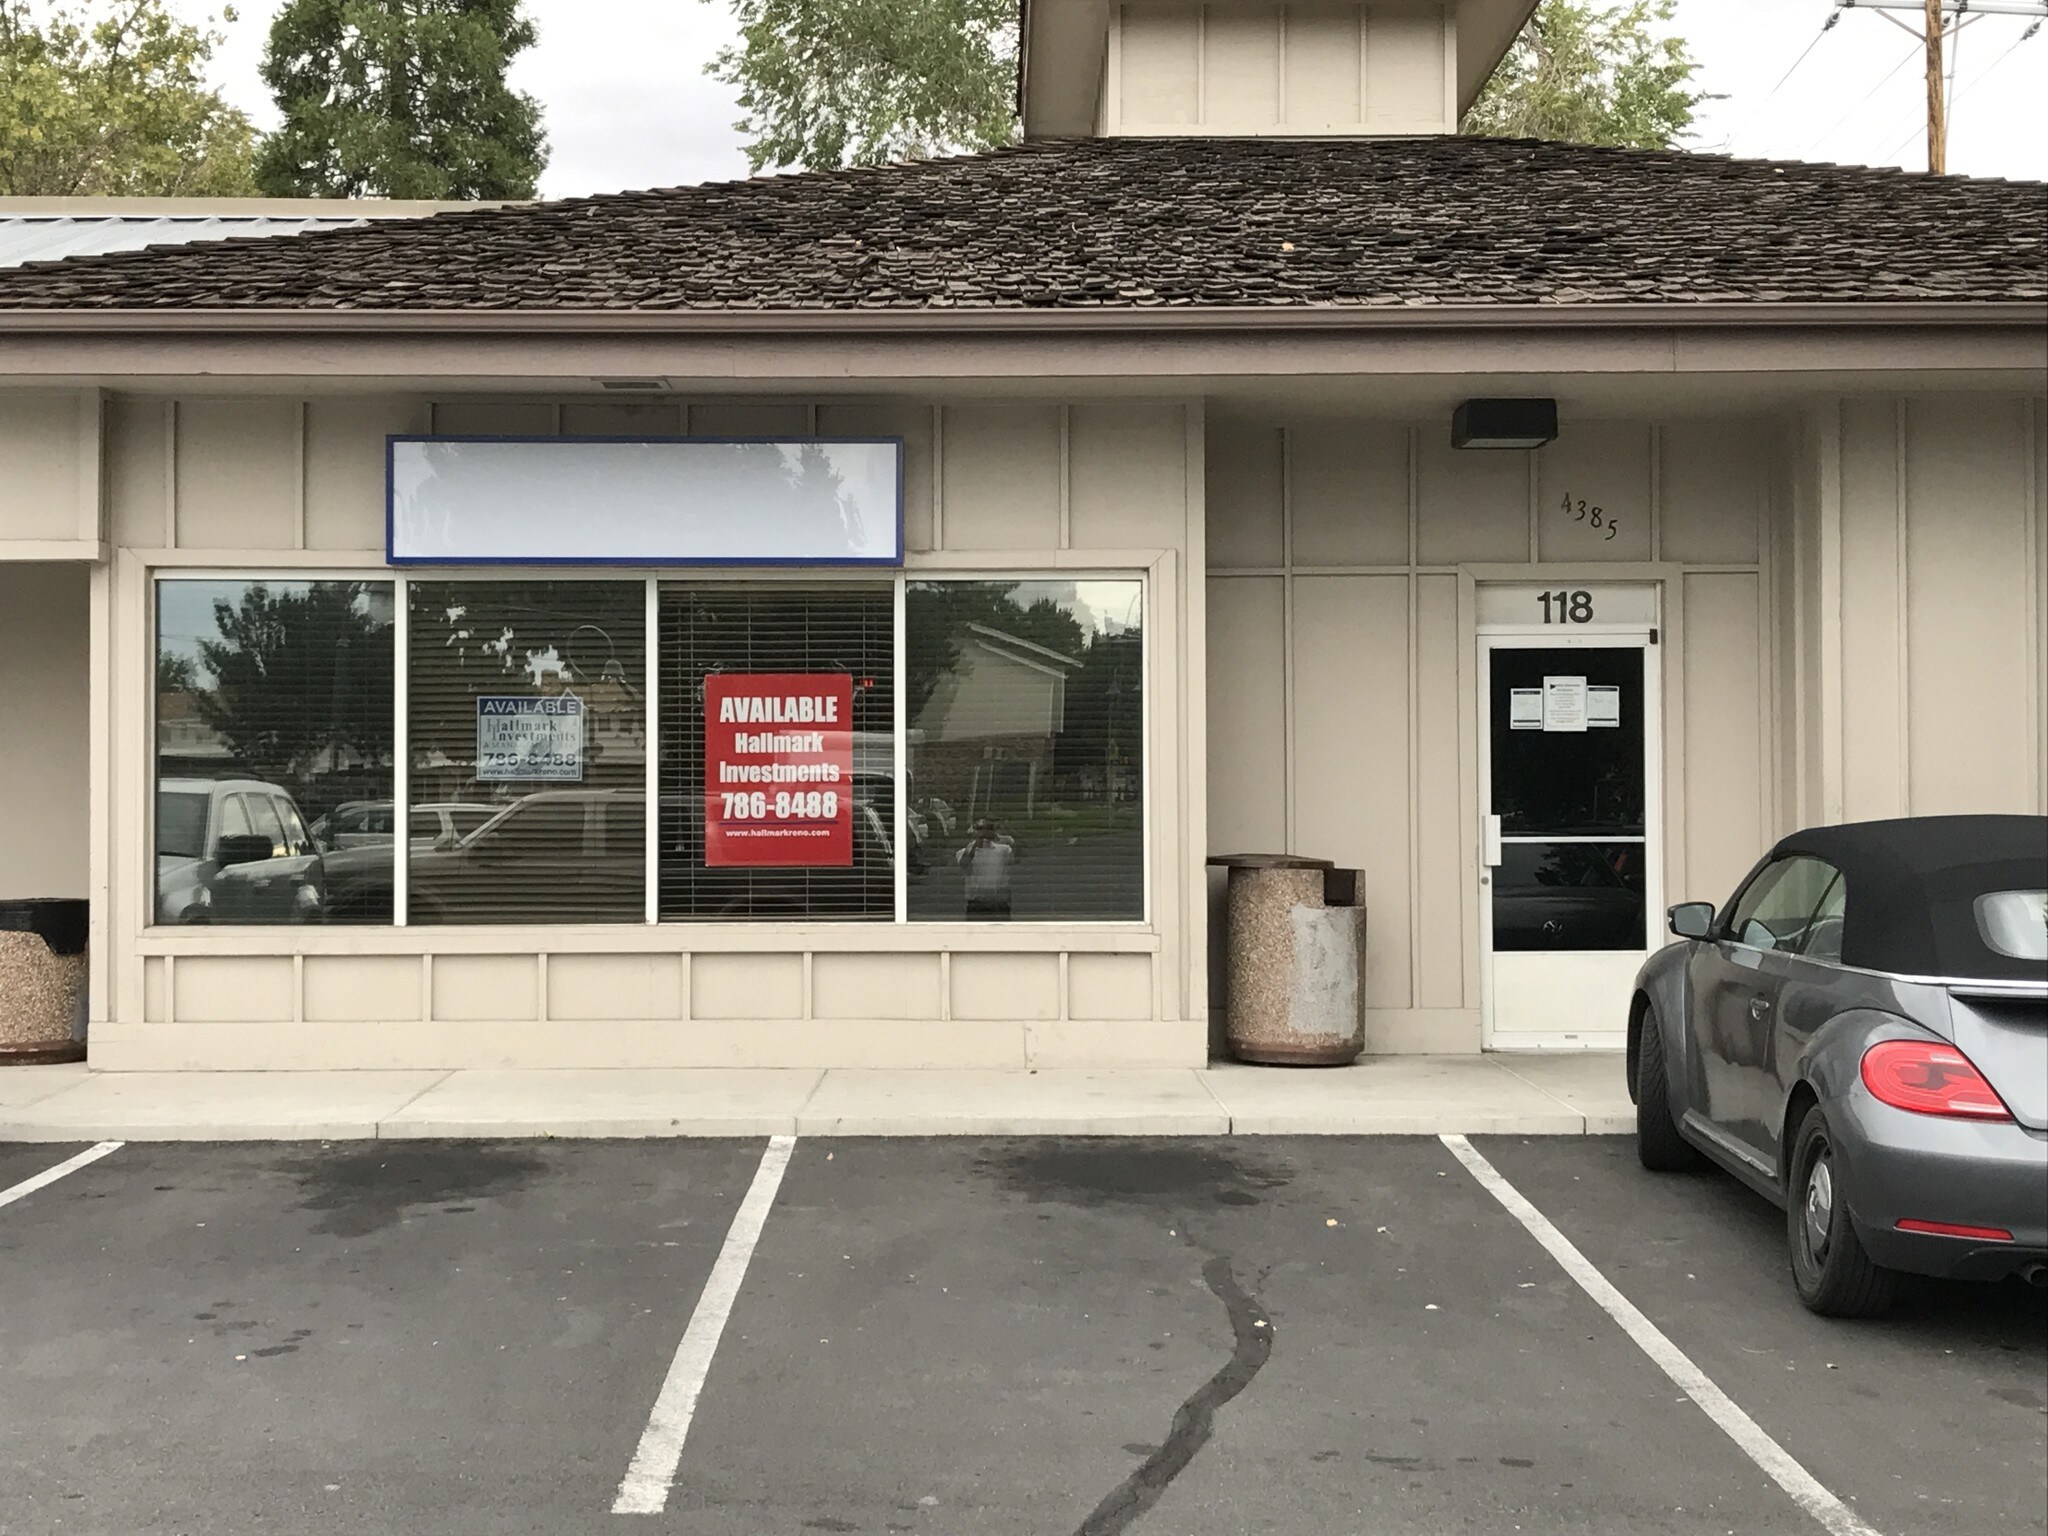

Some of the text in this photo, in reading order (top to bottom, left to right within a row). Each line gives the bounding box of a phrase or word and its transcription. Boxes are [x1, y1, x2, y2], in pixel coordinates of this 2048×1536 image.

[1561, 492, 1618, 541] 4385
[1537, 590, 1594, 624] 118
[484, 701, 577, 714] AVAILABLE
[720, 696, 838, 723] AVAILABLE
[486, 718, 557, 733] Hallmark
[492, 728, 576, 741] Investments
[734, 731, 824, 753] Hallmark
[483, 752, 576, 767] 786-8488
[719, 761, 840, 783] Investments
[720, 791, 838, 819] 786-8488
[725, 829, 830, 837] www.hallmarkreno.com
